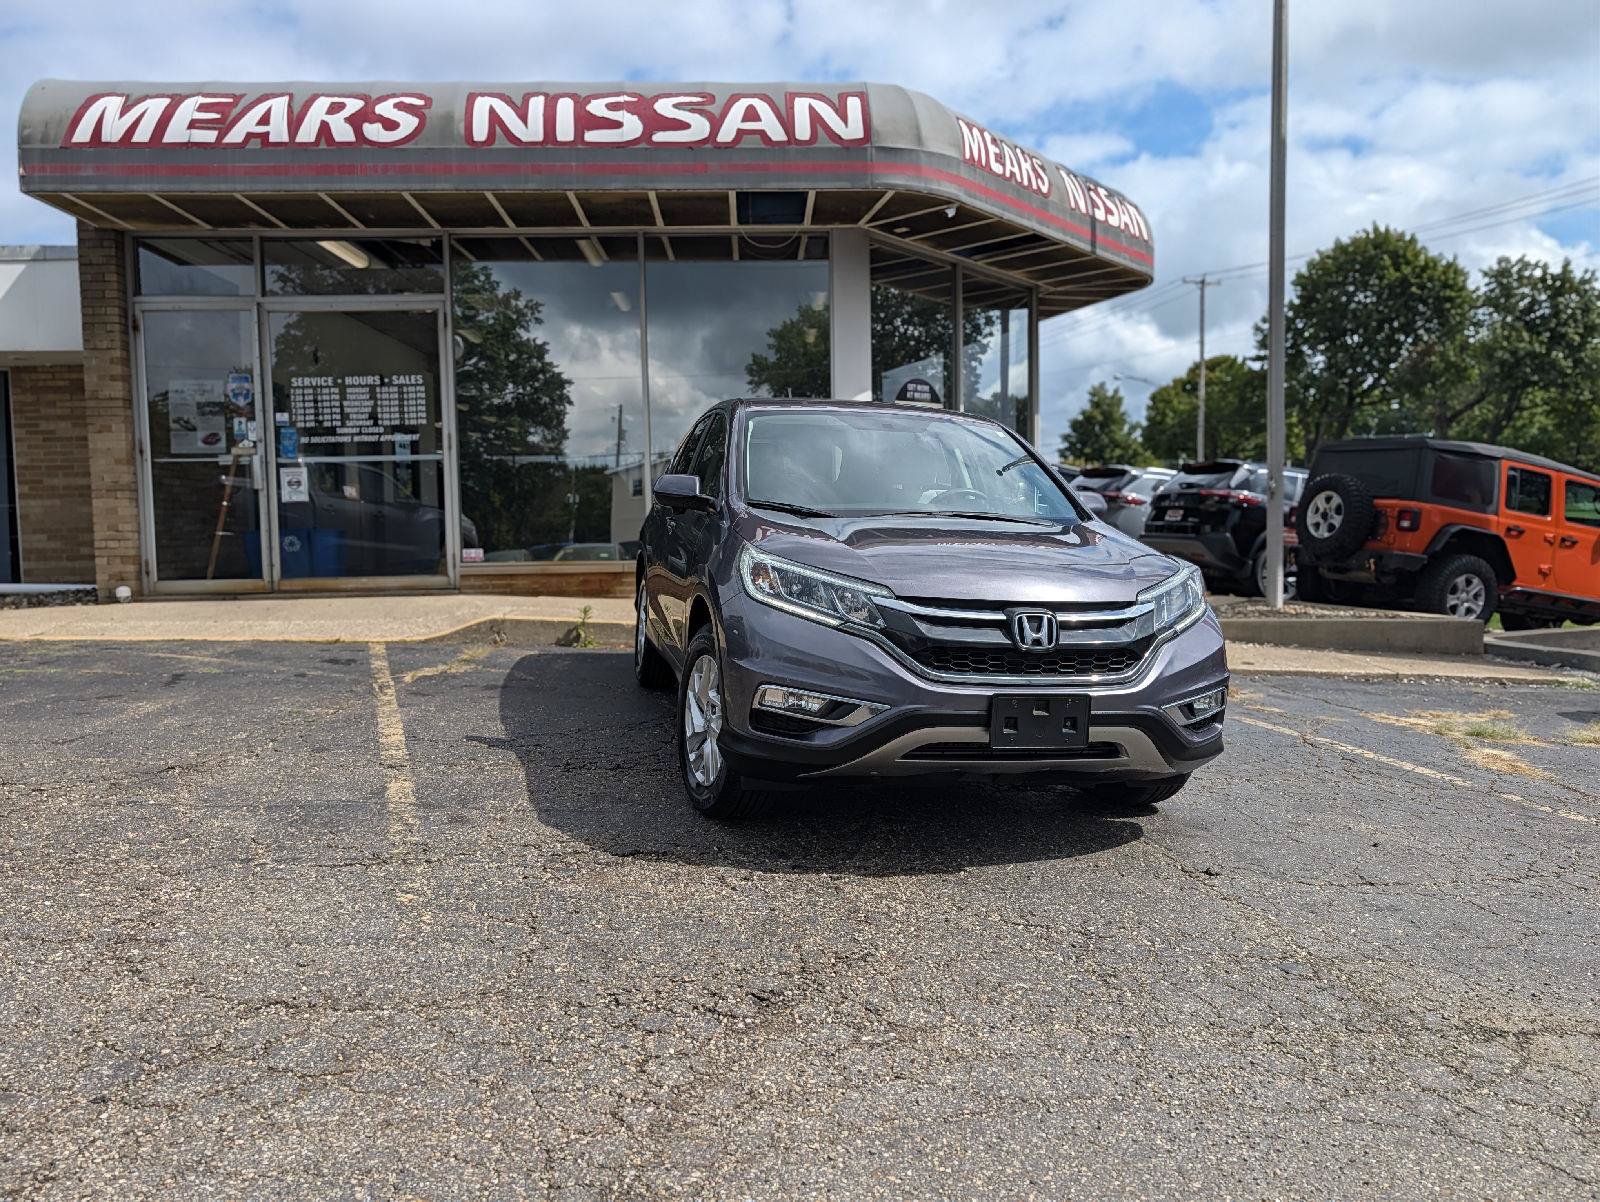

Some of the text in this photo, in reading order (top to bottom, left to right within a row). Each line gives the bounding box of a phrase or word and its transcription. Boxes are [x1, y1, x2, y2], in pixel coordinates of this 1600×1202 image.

[68, 93, 867, 146] MEARS NISSAN
[957, 118, 1150, 242] MEARS NISSAN
[290, 374, 423, 387] SERVICE HOURS SALES
